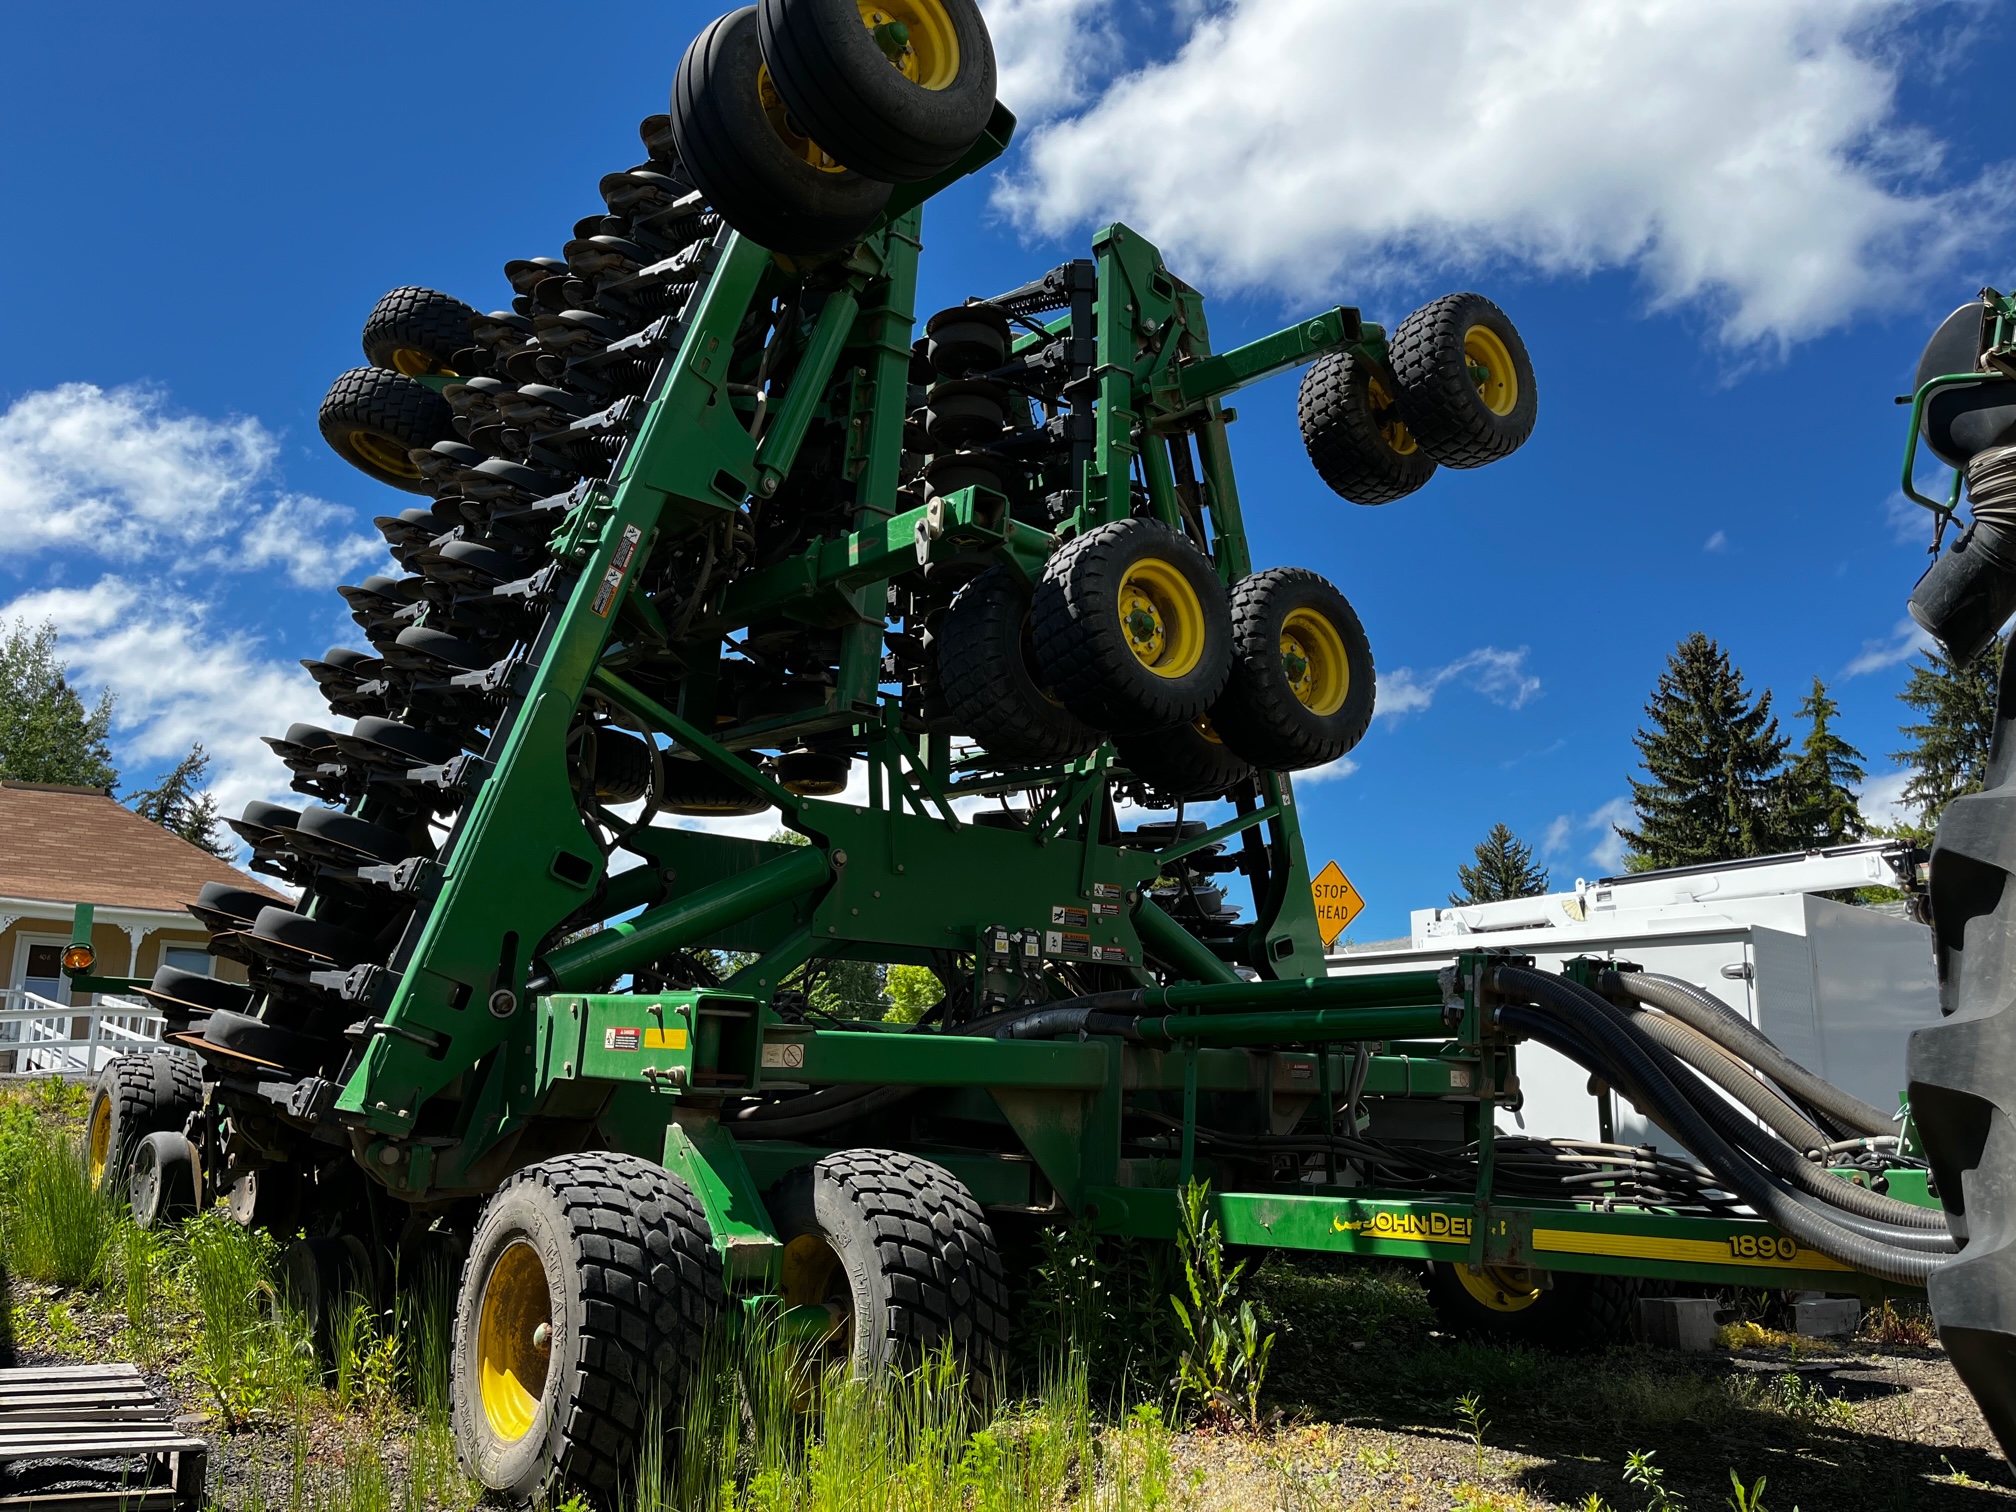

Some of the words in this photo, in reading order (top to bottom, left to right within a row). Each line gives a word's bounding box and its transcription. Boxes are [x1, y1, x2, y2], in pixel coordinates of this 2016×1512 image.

[1314, 884, 1348, 899] STOP
[1318, 905, 1348, 919] HEAD
[1728, 1234, 1797, 1259] 1890
[545, 1238, 566, 1349] TITAN
